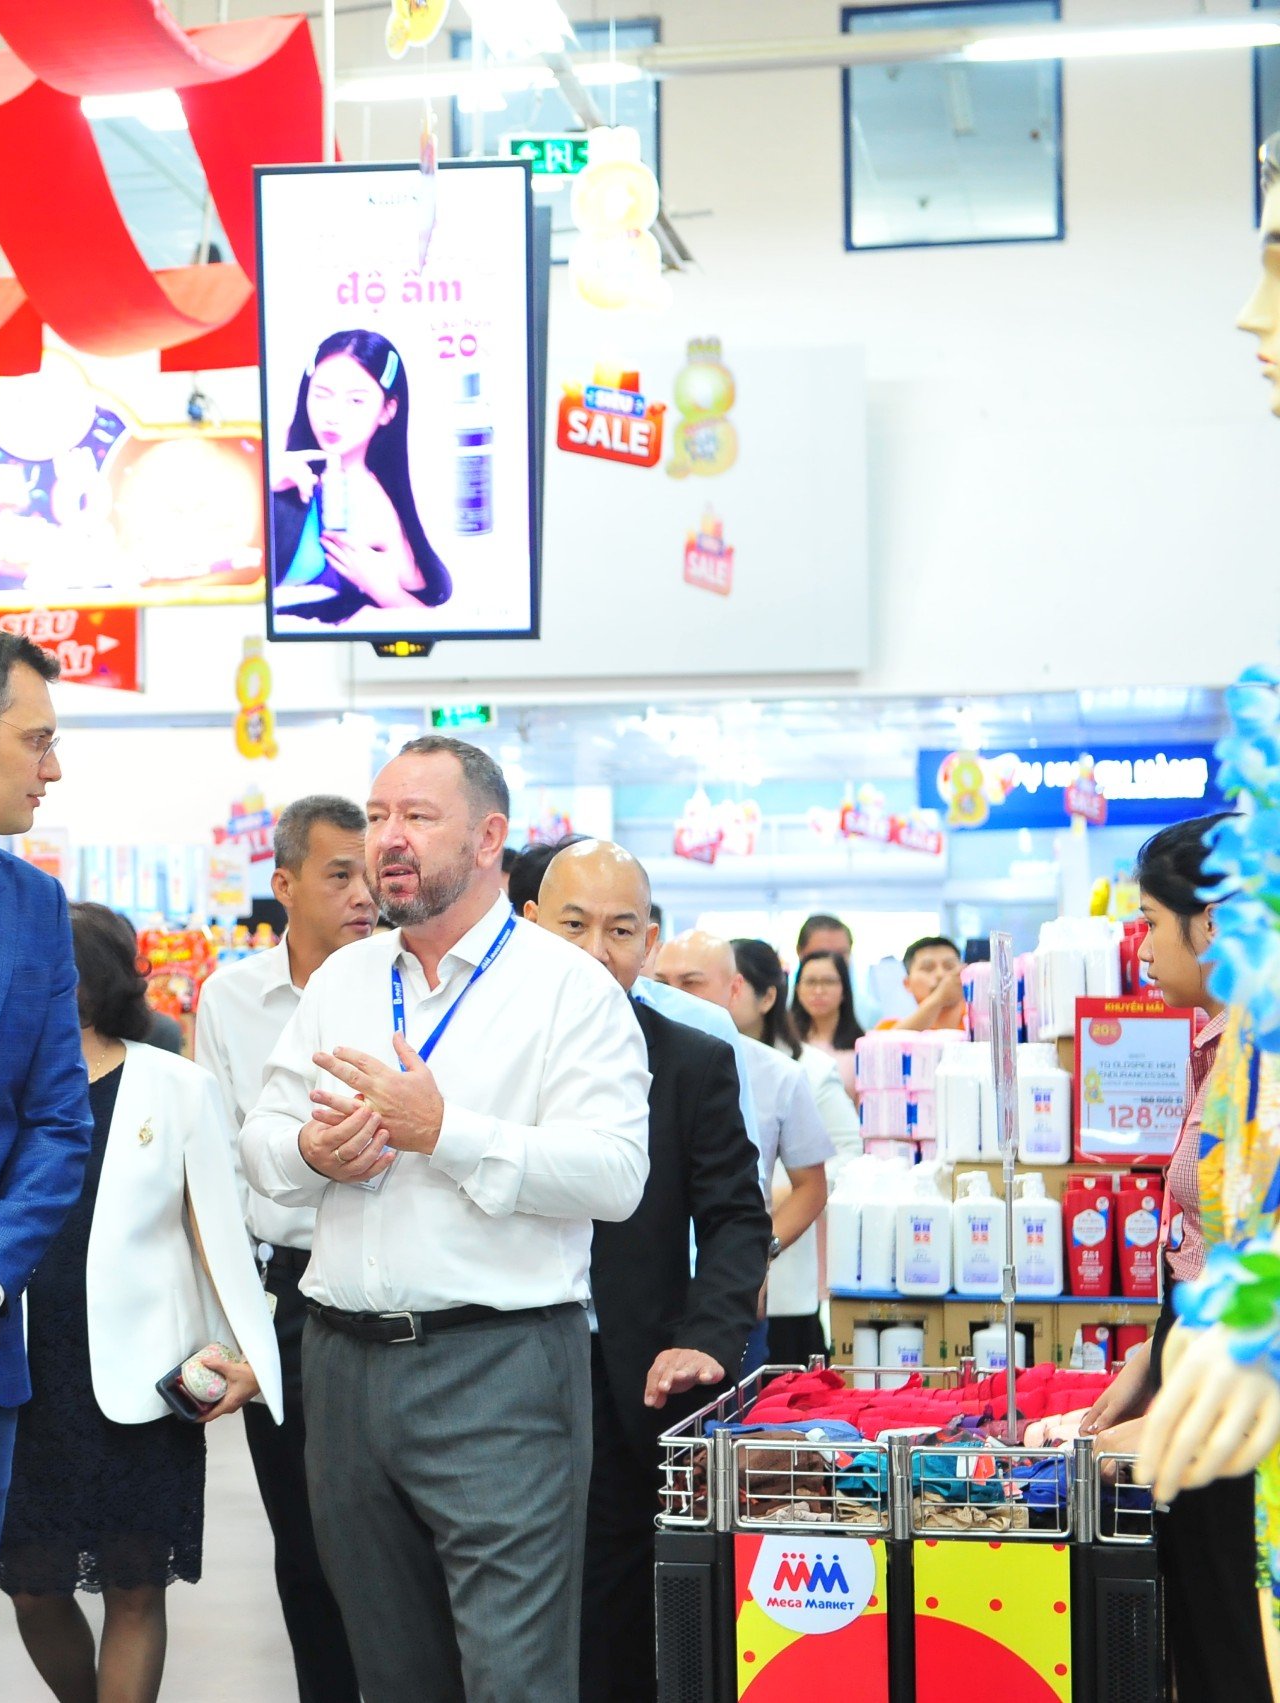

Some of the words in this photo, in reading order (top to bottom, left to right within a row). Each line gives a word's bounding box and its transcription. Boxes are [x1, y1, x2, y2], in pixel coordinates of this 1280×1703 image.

[337, 270, 386, 314] độ
[567, 408, 651, 458] SALE
[687, 551, 728, 587] SALE
[1104, 1001, 1144, 1013] KHUYẾN
[1146, 1001, 1164, 1012] MÃI
[1108, 1105, 1153, 1129] 128
[1156, 1105, 1184, 1118] 700
